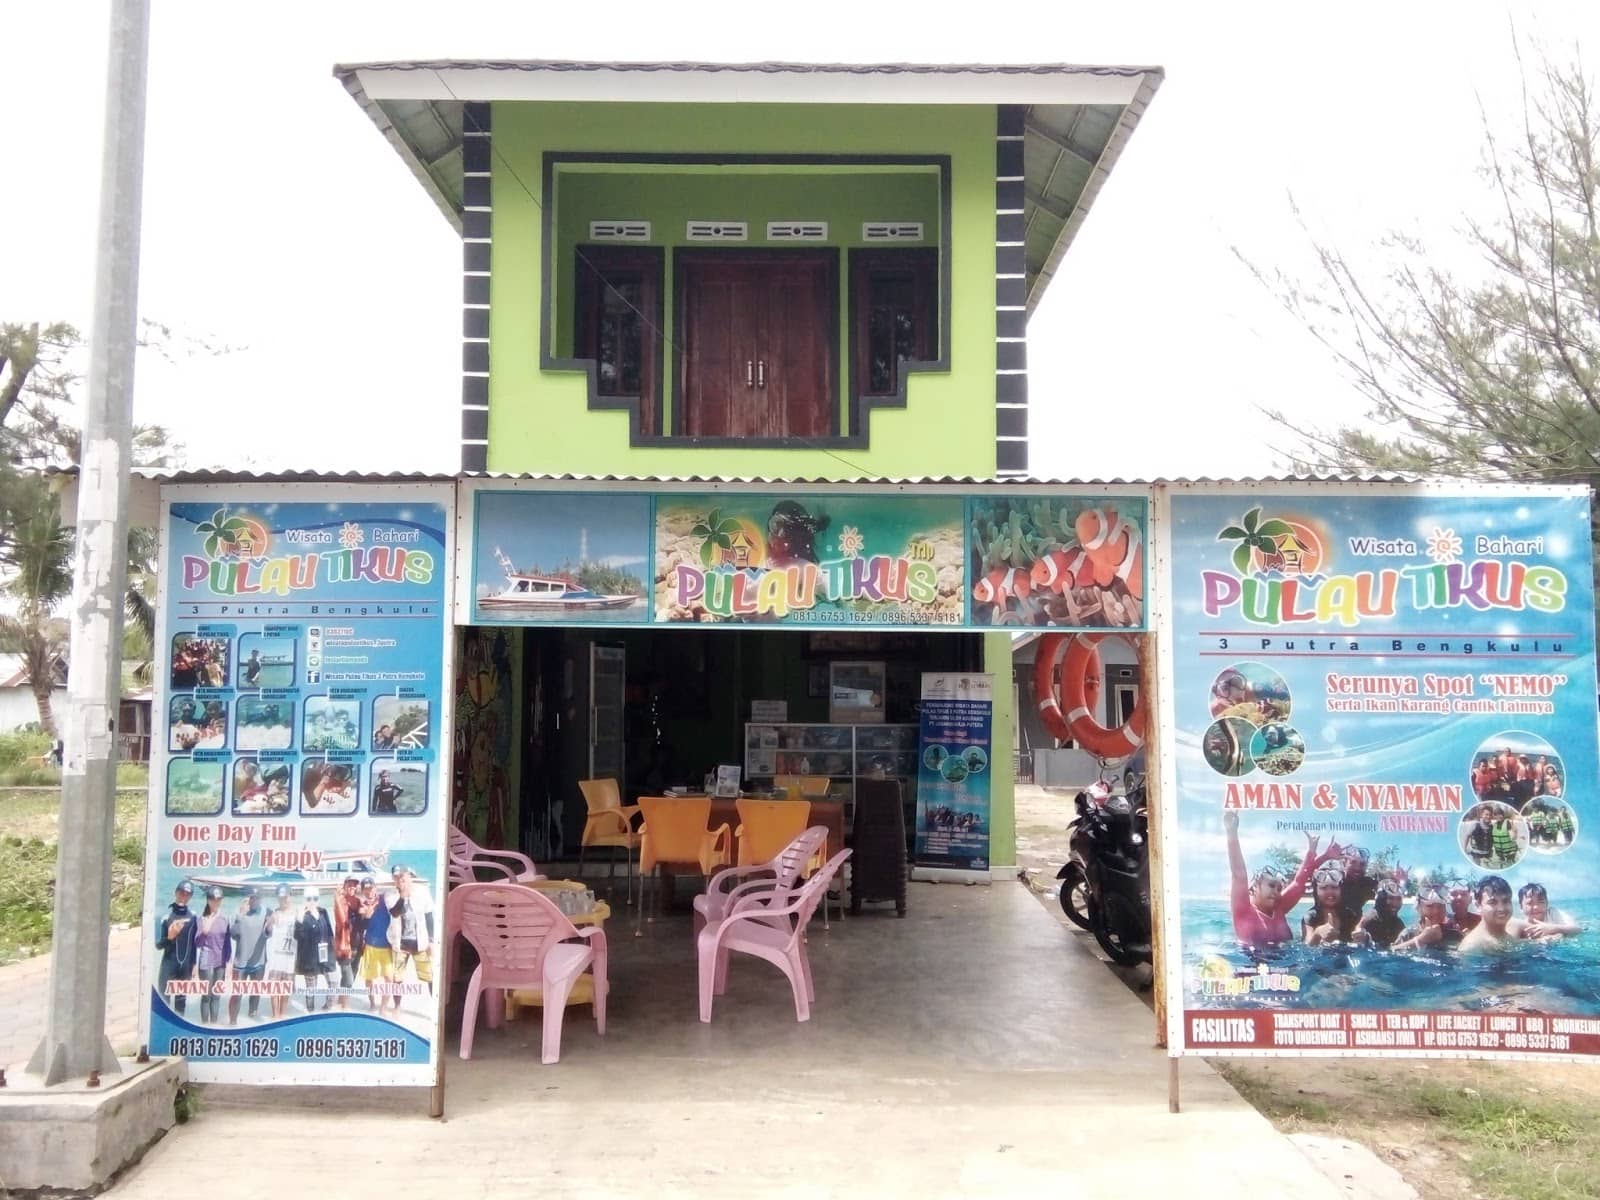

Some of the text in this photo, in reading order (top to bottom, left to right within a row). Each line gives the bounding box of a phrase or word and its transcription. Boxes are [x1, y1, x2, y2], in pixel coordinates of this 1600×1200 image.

[286, 528, 420, 544] Wisata Bahari
[910, 542, 936, 560] Trip
[1350, 537, 1544, 555] Wisata Bahari
[182, 546, 434, 596] PULAU TIKUS
[674, 555, 938, 617] PULAU TIKUS
[1201, 560, 1569, 626] PULAU TIKUS
[192, 605, 429, 617] 3 Putra Bengkulu
[793, 611, 817, 621] 0813
[820, 612, 845, 621] 6753
[850, 612, 873, 622] 1629
[882, 612, 906, 622] 0896
[1219, 638, 1563, 655] 3 Putra Bengkulu
[1327, 674, 1418, 697] Serunya
[1424, 675, 1473, 697] Spot
[1327, 699, 1361, 712] Serta
[1365, 699, 1396, 712] Ikan
[1400, 700, 1450, 714] Karang
[1454, 700, 1496, 713] Cantik
[1224, 783, 1463, 811] AMAN & NYAMAN
[1381, 815, 1449, 832] ASURANSI
[173, 824, 297, 843] One Day Fun
[172, 850, 322, 869] One Day Happy
[166, 981, 294, 995] AMAN & NYAMAN
[374, 983, 422, 995] ASURANSI
[1192, 1018, 1255, 1042] FASILITAS
[1273, 1014, 1319, 1028] TRANSPORT
[1437, 1015, 1452, 1029] LIFE
[1274, 1030, 1294, 1045] FOTO
[1295, 1030, 1346, 1045] UNDERWATER
[170, 1039, 205, 1057] 0813
[207, 1039, 243, 1057] 6753
[245, 1039, 279, 1057] 1629
[296, 1040, 334, 1058] 0896
[336, 1040, 373, 1058] 5337
[374, 1040, 406, 1058] 5181
